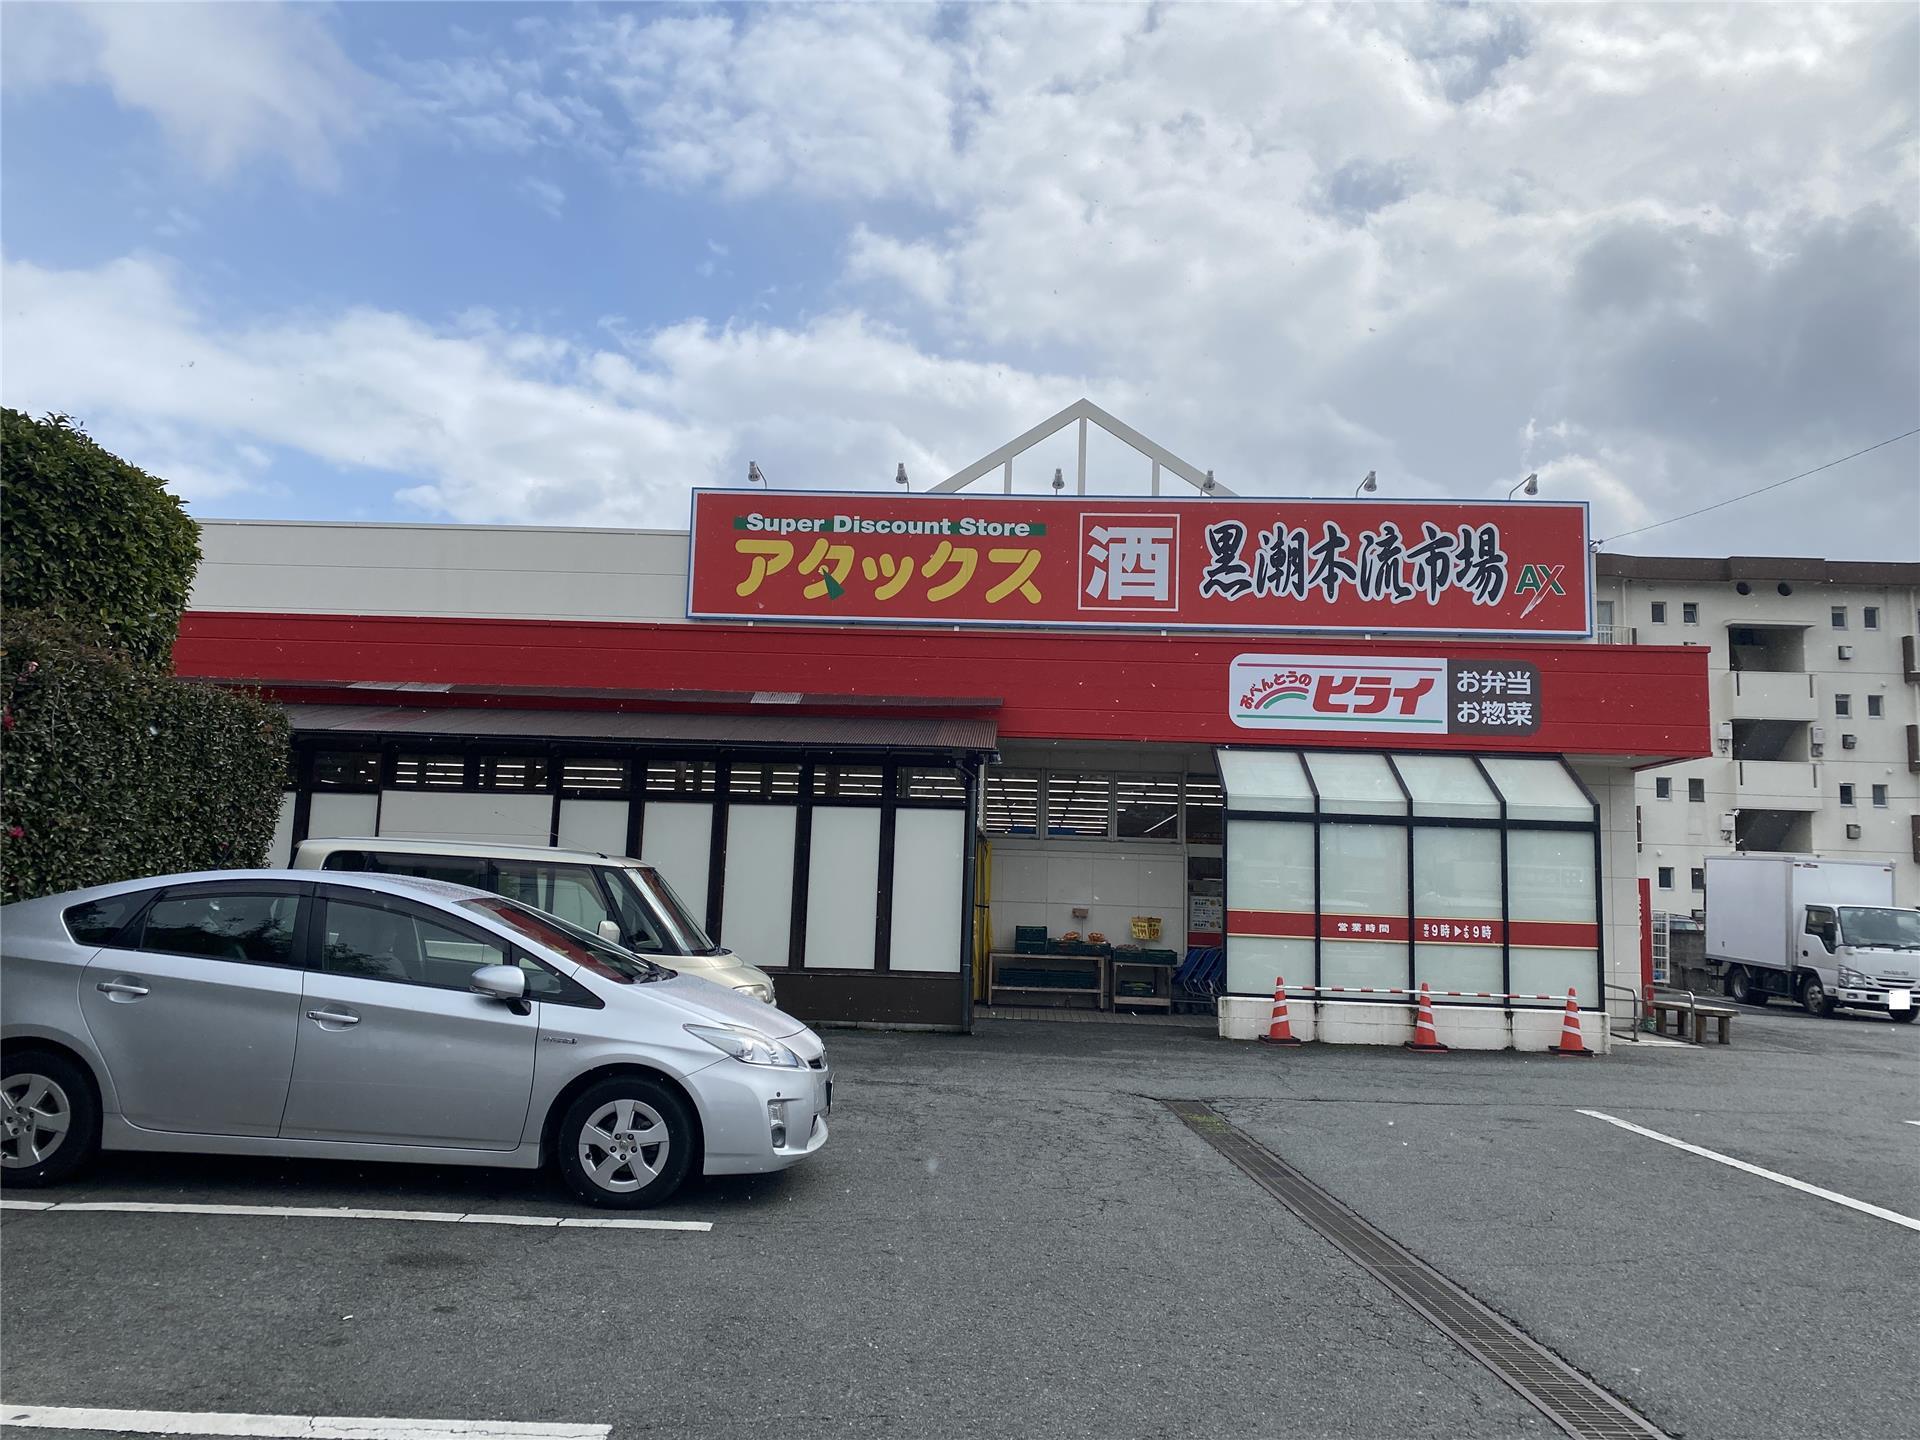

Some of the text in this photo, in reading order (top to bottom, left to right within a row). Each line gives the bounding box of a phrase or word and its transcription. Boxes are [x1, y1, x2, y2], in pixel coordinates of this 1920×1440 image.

[746, 513, 1030, 538] Super Discount Store
[735, 537, 1042, 604] アタックス
[1086, 525, 1173, 602] 酒
[1200, 520, 1509, 607] 黒潮本流市場
[1514, 563, 1567, 618] AX
[1239, 671, 1312, 710] おべんとうの
[1312, 675, 1435, 715] ヒライ
[1457, 669, 1531, 695] お弁当
[1457, 700, 1533, 727] お惣菜
[1337, 922, 1390, 934] 営業時間
